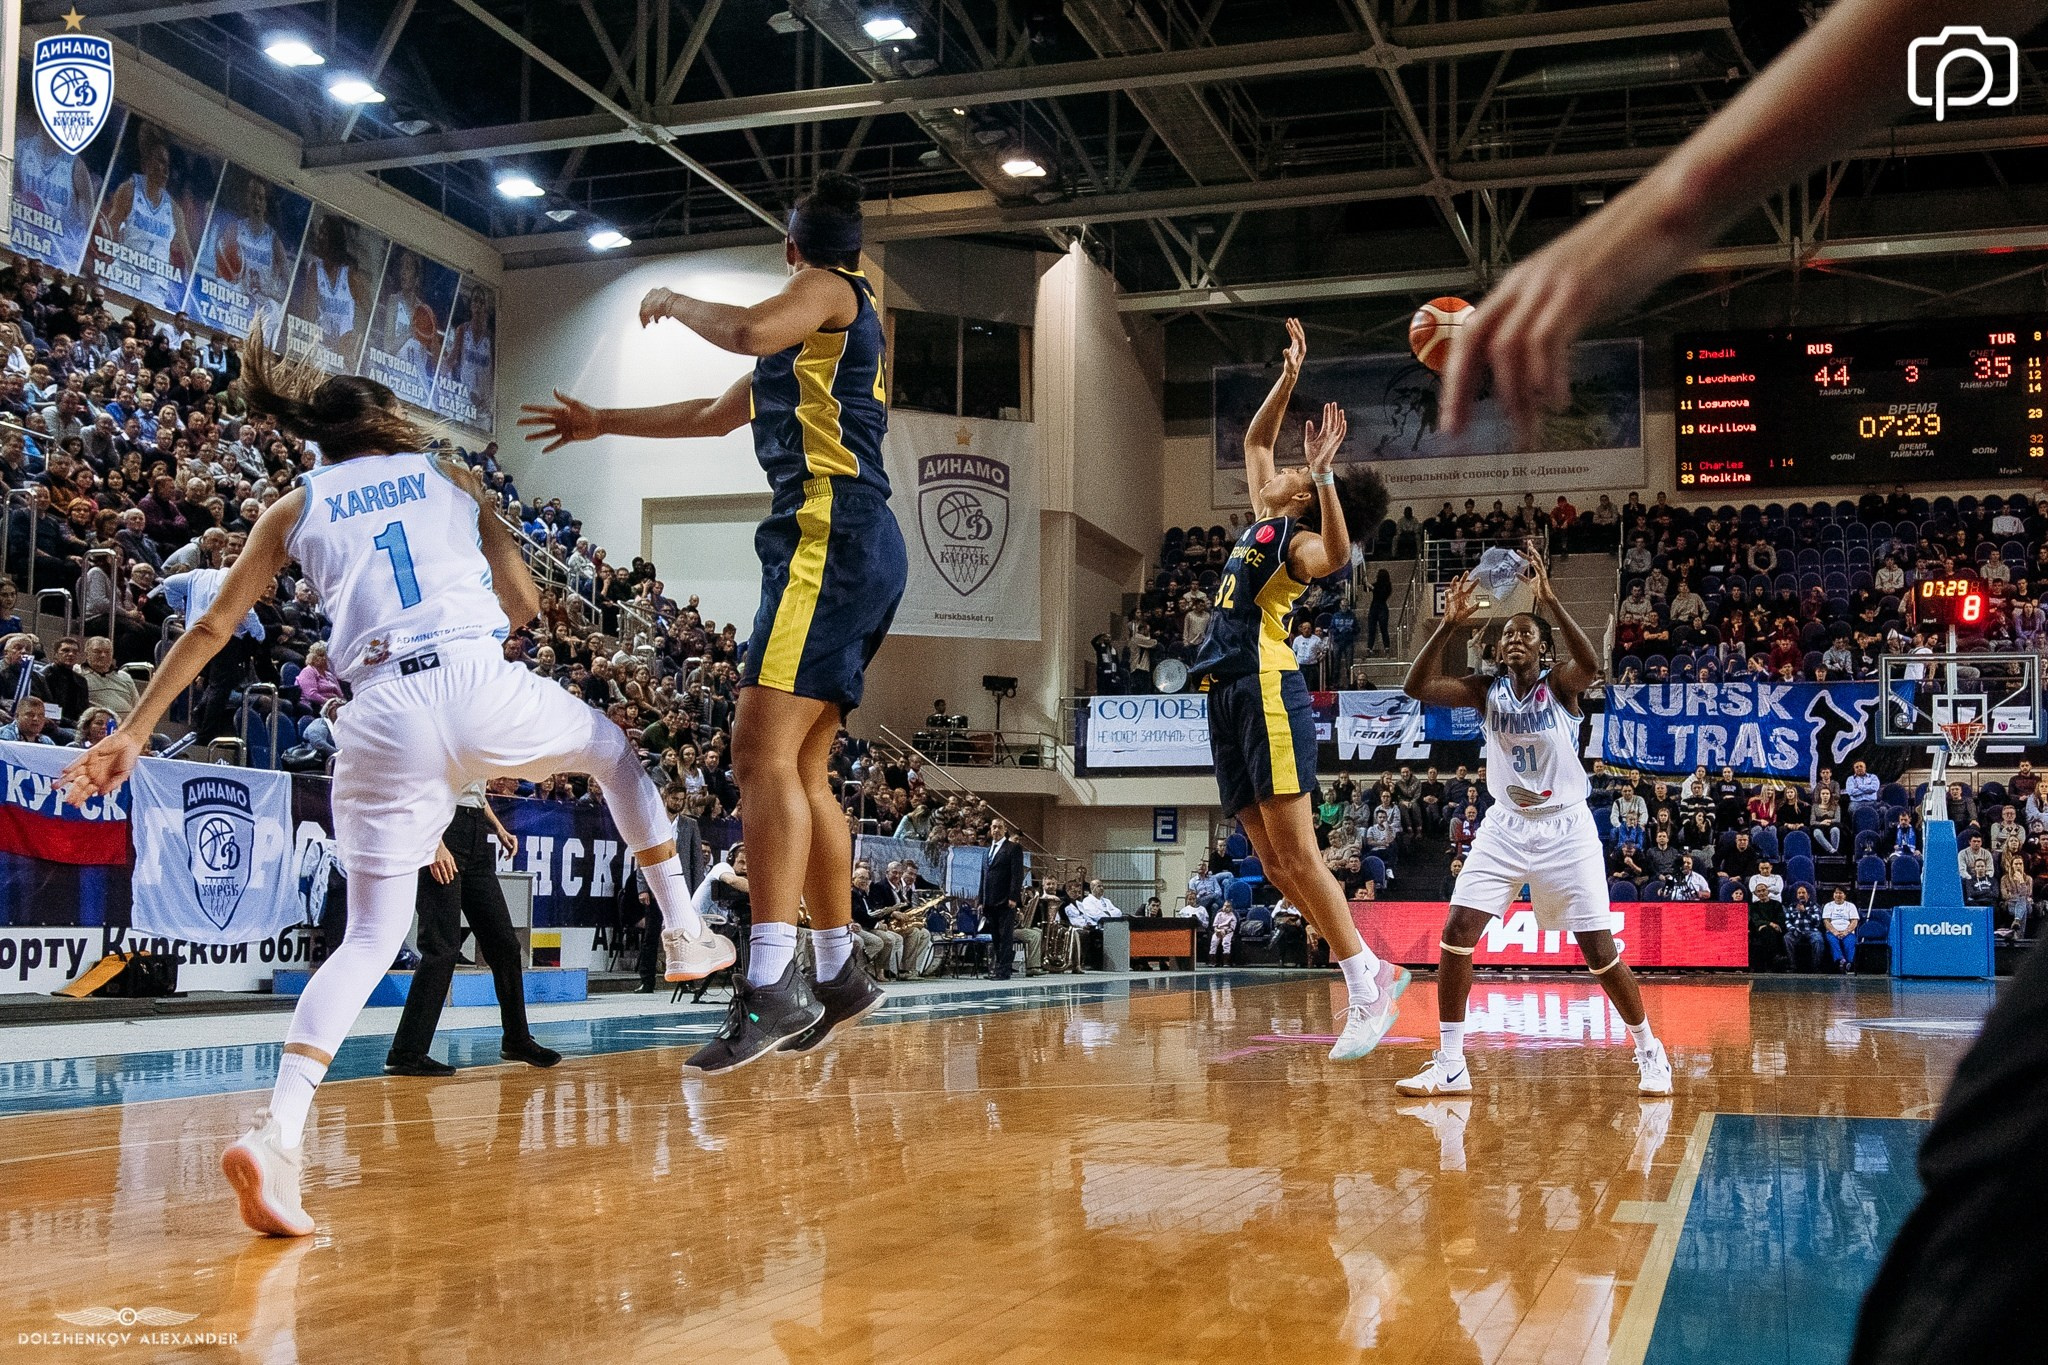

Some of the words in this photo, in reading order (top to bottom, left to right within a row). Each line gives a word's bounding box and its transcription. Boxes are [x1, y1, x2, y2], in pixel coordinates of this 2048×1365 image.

[94, 235, 182, 283] ЧЕРЕМИСИНА
[94, 258, 141, 290] МАРИЯ
[201, 278, 250, 310] ВИДМЕР
[200, 301, 249, 331] ТАТЬЯН
[1989, 333, 2016, 345] TUR
[2033, 331, 2042, 341] 8
[1686, 351, 1694, 360] 3
[1699, 349, 1736, 358] Zhedik
[1807, 344, 1833, 354] RUS
[1969, 349, 1996, 358] СЧЕТ
[370, 347, 418, 378] ЛОГУНОВА
[1829, 357, 1854, 365] СЧЕТ
[1895, 358, 1929, 366] ПЕРИОД
[2028, 357, 2041, 367] 11
[1974, 356, 2012, 379] 35
[1685, 376, 1694, 385] 9
[1698, 373, 1756, 384] Levchenko
[1814, 365, 1850, 387] 44
[1905, 365, 1919, 383] 3
[2028, 370, 2042, 380] 12
[369, 368, 424, 400] АНАСТАСИЯ
[439, 376, 469, 399] МАРТА
[1960, 380, 2009, 389] ТАЙМ-АУТЫ
[2028, 383, 2042, 393] 14
[1819, 387, 1866, 396] ТАЙМ-АУТЫ
[1681, 400, 1693, 410] 11
[1698, 400, 1750, 410] Logunova
[1888, 402, 1938, 415] ВРЕМЯ
[2028, 408, 2043, 419] 23
[1681, 425, 1694, 435] 13
[1699, 423, 1757, 433] Kirillova
[1859, 413, 1941, 439] 07:29
[2030, 434, 2044, 444] 32
[1898, 443, 1928, 451] ВРЕМЯ
[1972, 446, 1998, 455] ФОЛЫ
[2030, 447, 2044, 458] 33
[1830, 453, 1856, 461] ФОЛЫ
[1890, 450, 1935, 459] ТАЙМ-АУТА
[1681, 461, 1693, 471] 31
[1700, 461, 1744, 470] Charles
[1782, 458, 1794, 467] 14
[924, 458, 1005, 484] ДИНАМО
[1385, 470, 1460, 484] Генеральный
[1462, 468, 1510, 480] спонсор
[1512, 467, 1528, 477] БК
[1530, 465, 1590, 477] «Динамо»
[1681, 474, 1695, 484] 33
[1700, 473, 1751, 483] Anoikina
[325, 473, 427, 523] XARGAY
[373, 520, 422, 610] 1
[1963, 594, 1981, 621] 8
[934, 612, 994, 622] kurskbasket.ru
[1613, 682, 1793, 719] KURSK
[1491, 707, 1556, 735] DYNAMO
[1097, 731, 1107, 743] НЕ
[1353, 730, 1402, 740] ГЕПАРД
[1607, 715, 1800, 770] ULTRAS
[1512, 744, 1538, 773] 31
[187, 782, 248, 808] ДИНАМО
[1914, 922, 1972, 936] molten
